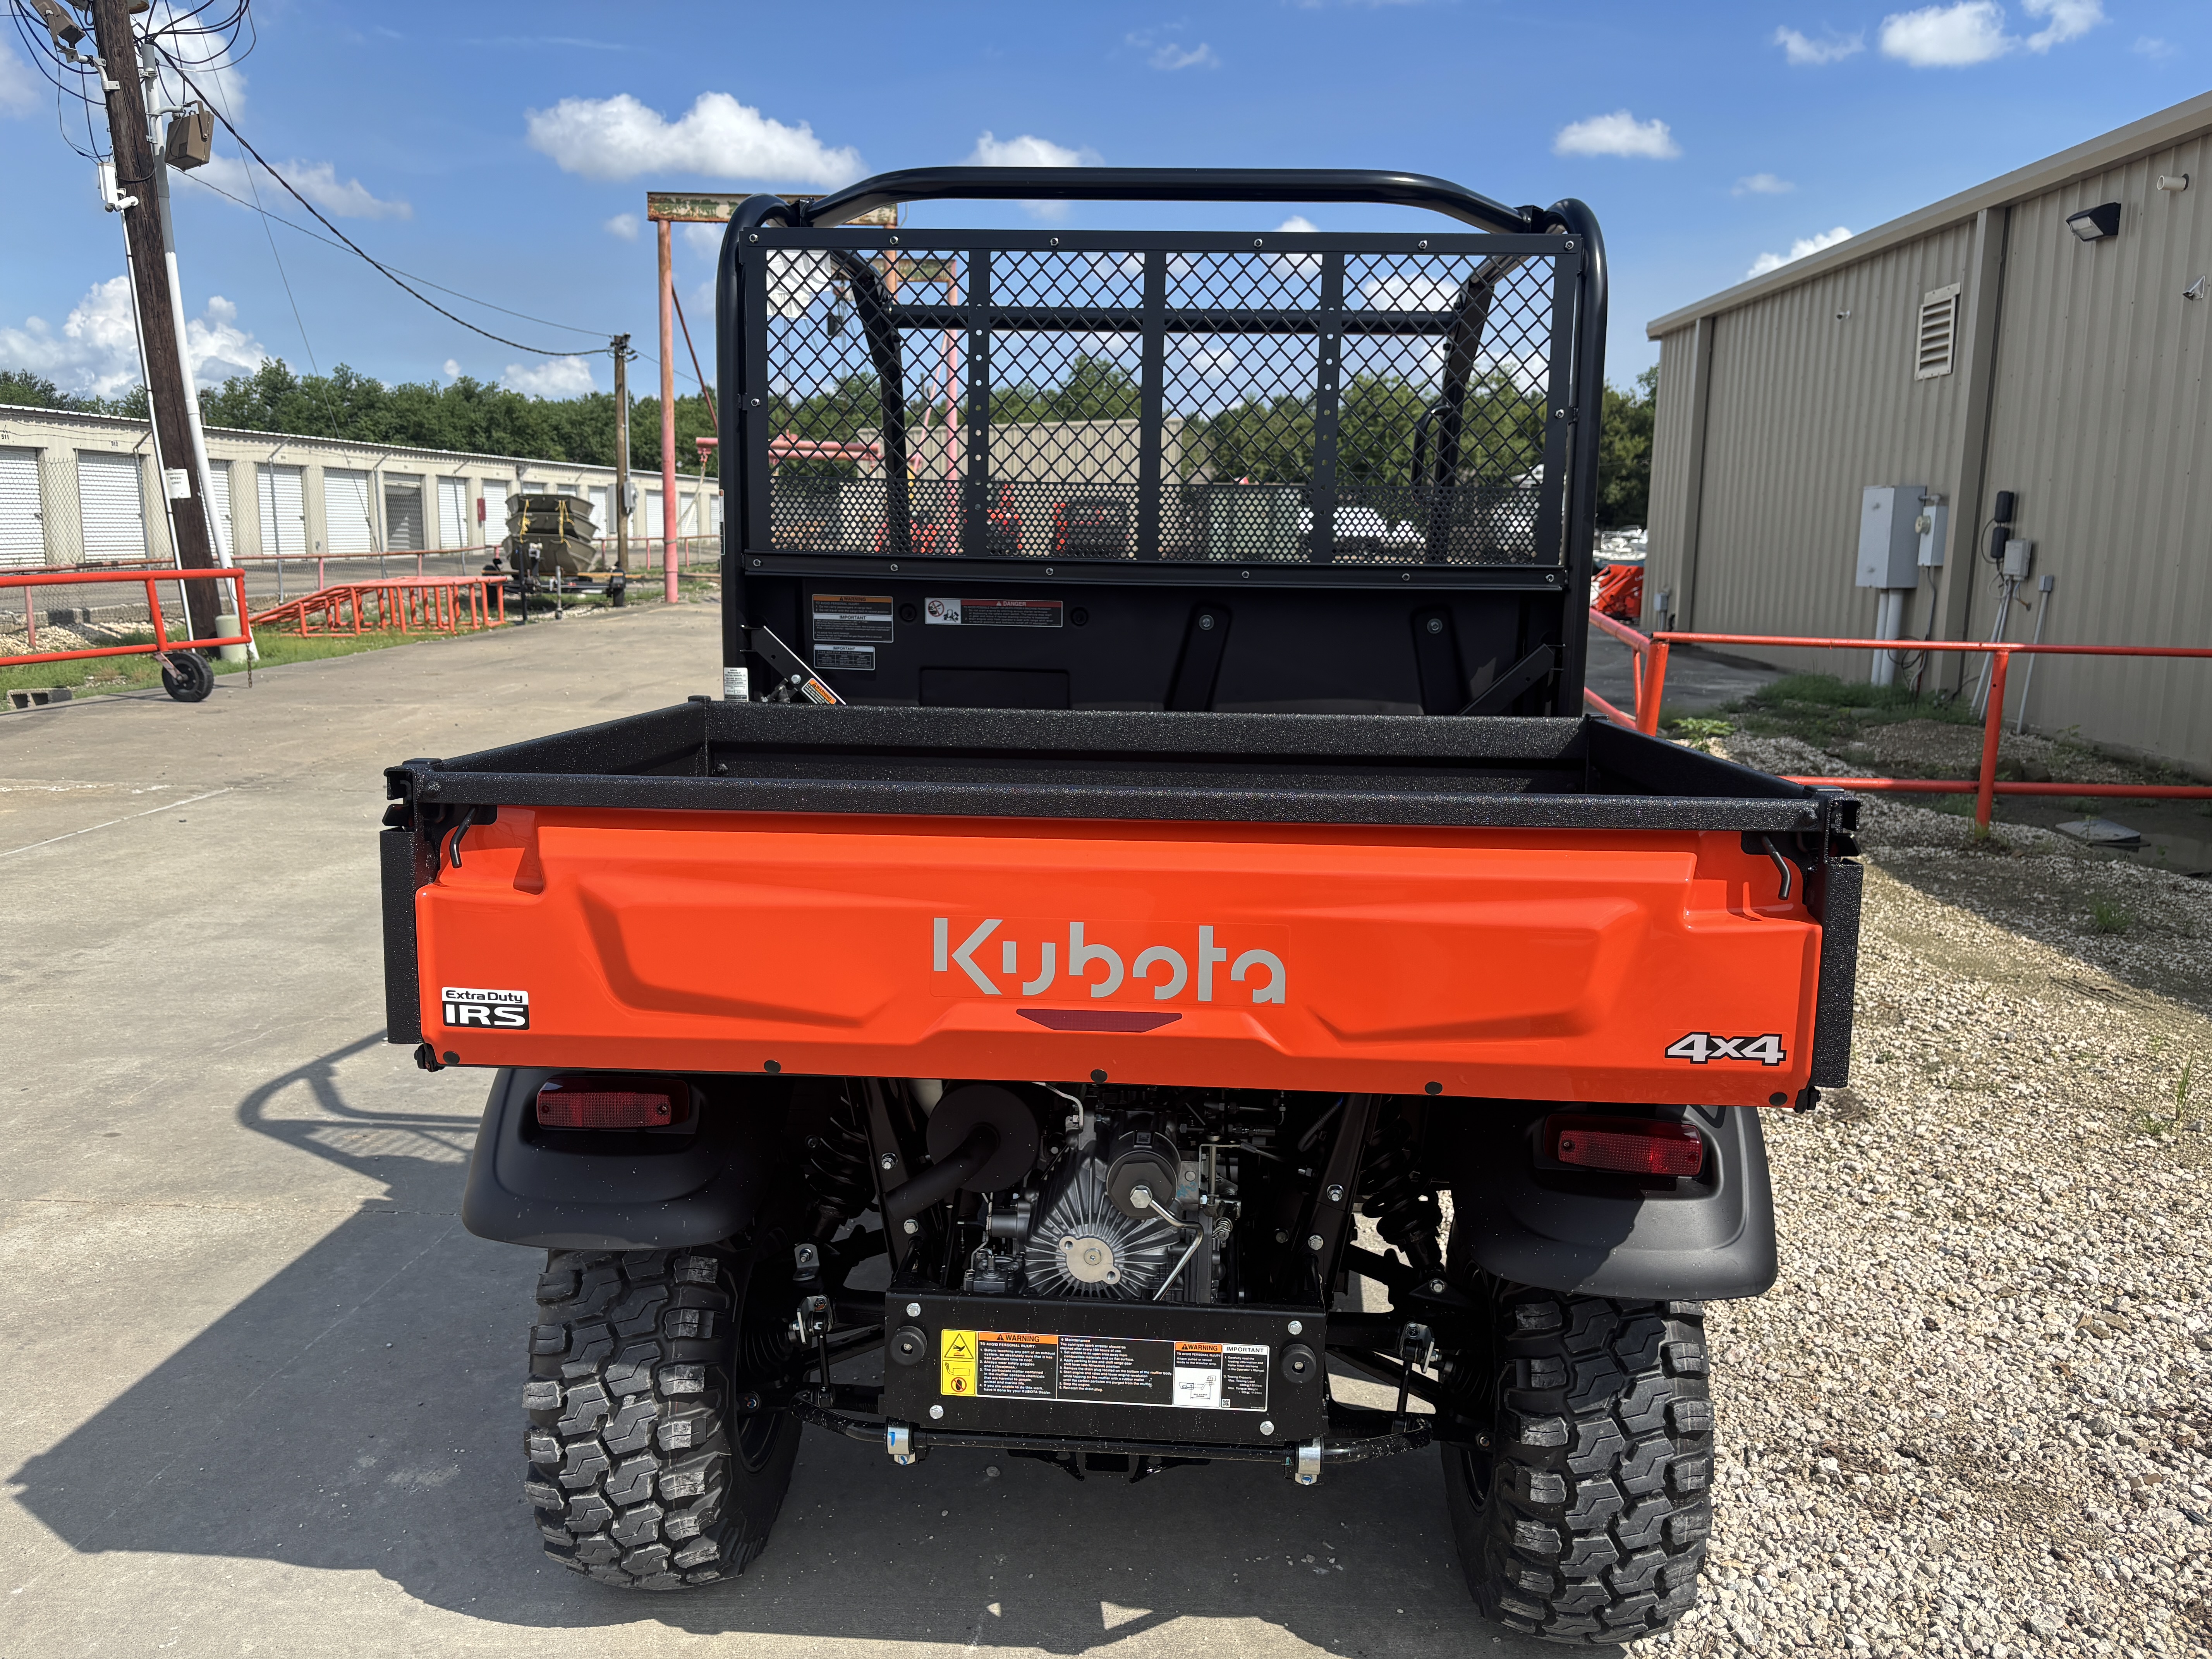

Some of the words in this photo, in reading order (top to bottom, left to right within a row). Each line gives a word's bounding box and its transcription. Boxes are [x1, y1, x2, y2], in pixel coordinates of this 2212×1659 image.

[816, 684, 832, 701] WARNING
[933, 917, 1285, 1004] Kubota
[446, 990, 485, 1000] Extra
[488, 992, 522, 1003] Duty
[446, 1004, 526, 1026] IRS
[1666, 1033, 1785, 1065] 4x4
